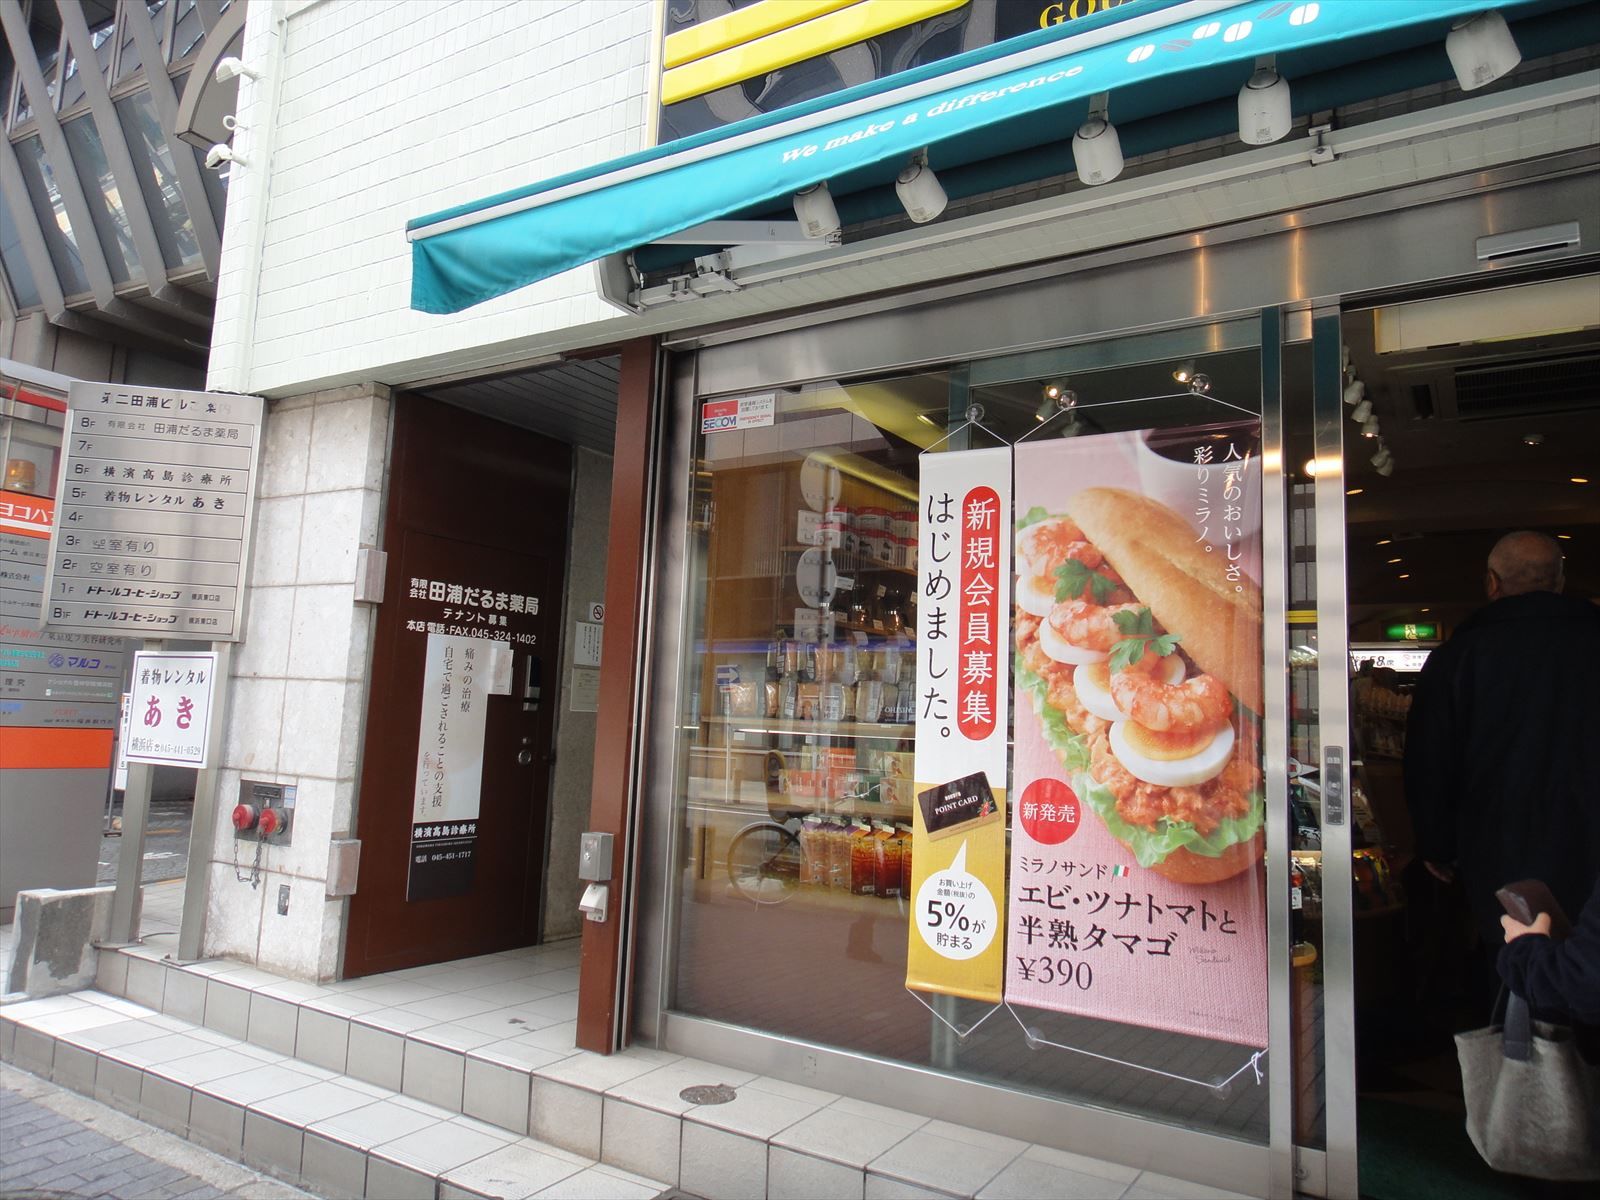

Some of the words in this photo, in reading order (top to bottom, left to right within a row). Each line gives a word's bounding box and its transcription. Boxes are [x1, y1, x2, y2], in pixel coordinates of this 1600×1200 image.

[782, 145, 818, 164] We
[824, 120, 896, 152] make
[902, 112, 919, 126] a
[927, 65, 1084, 118] difference
[81, 417, 95, 428] 8F
[108, 420, 146, 431] 有限会社
[154, 422, 239, 440] 田浦だるま薬局
[703, 416, 737, 429] SECOM
[78, 440, 92, 451] 7F
[74, 464, 91, 475] 6F
[71, 487, 87, 498] 5F
[104, 490, 185, 506] 着物レンタル
[192, 496, 226, 510] あき
[1193, 445, 1213, 552] 彩りミラノ。
[68, 511, 84, 522] 4F
[1222, 443, 1243, 593] 人気のおいしさ。
[65, 535, 80, 546] 3F
[92, 538, 156, 553] 空室有り
[62, 558, 78, 570] 2F
[90, 561, 152, 576] 空室有り
[61, 583, 75, 593] 1F
[87, 585, 182, 600] ドトールコーヒーショップ
[411, 577, 428, 589] 有限
[409, 588, 427, 599] 会社
[429, 580, 539, 616] 田浦だるま薬局
[84, 609, 179, 623] ドトールコーヒーショップ
[443, 608, 508, 627] テナント募集
[923, 492, 954, 739] はじめました。
[961, 497, 996, 726] 新規会員募集
[406, 619, 425, 633] 本店
[68, 657, 101, 669] マルコ
[141, 668, 207, 687] 着物レンタル
[460, 647, 475, 713] 痛みの治療
[144, 695, 194, 730] あき
[432, 646, 454, 808] 自宅で過ごされることの支援
[935, 803, 958, 815] POINT
[958, 795, 979, 807] CARD
[1023, 802, 1076, 824] 新発売
[1020, 856, 1108, 880] ミラノサンド
[939, 878, 973, 889] お買い上げ
[927, 900, 986, 934] 5%が
[1018, 884, 1238, 936] エビ・ツナトマトと
[936, 932, 973, 950] 貯まる
[1017, 914, 1179, 957] 半熟タマゴ
[1017, 956, 1093, 991] ¥390
